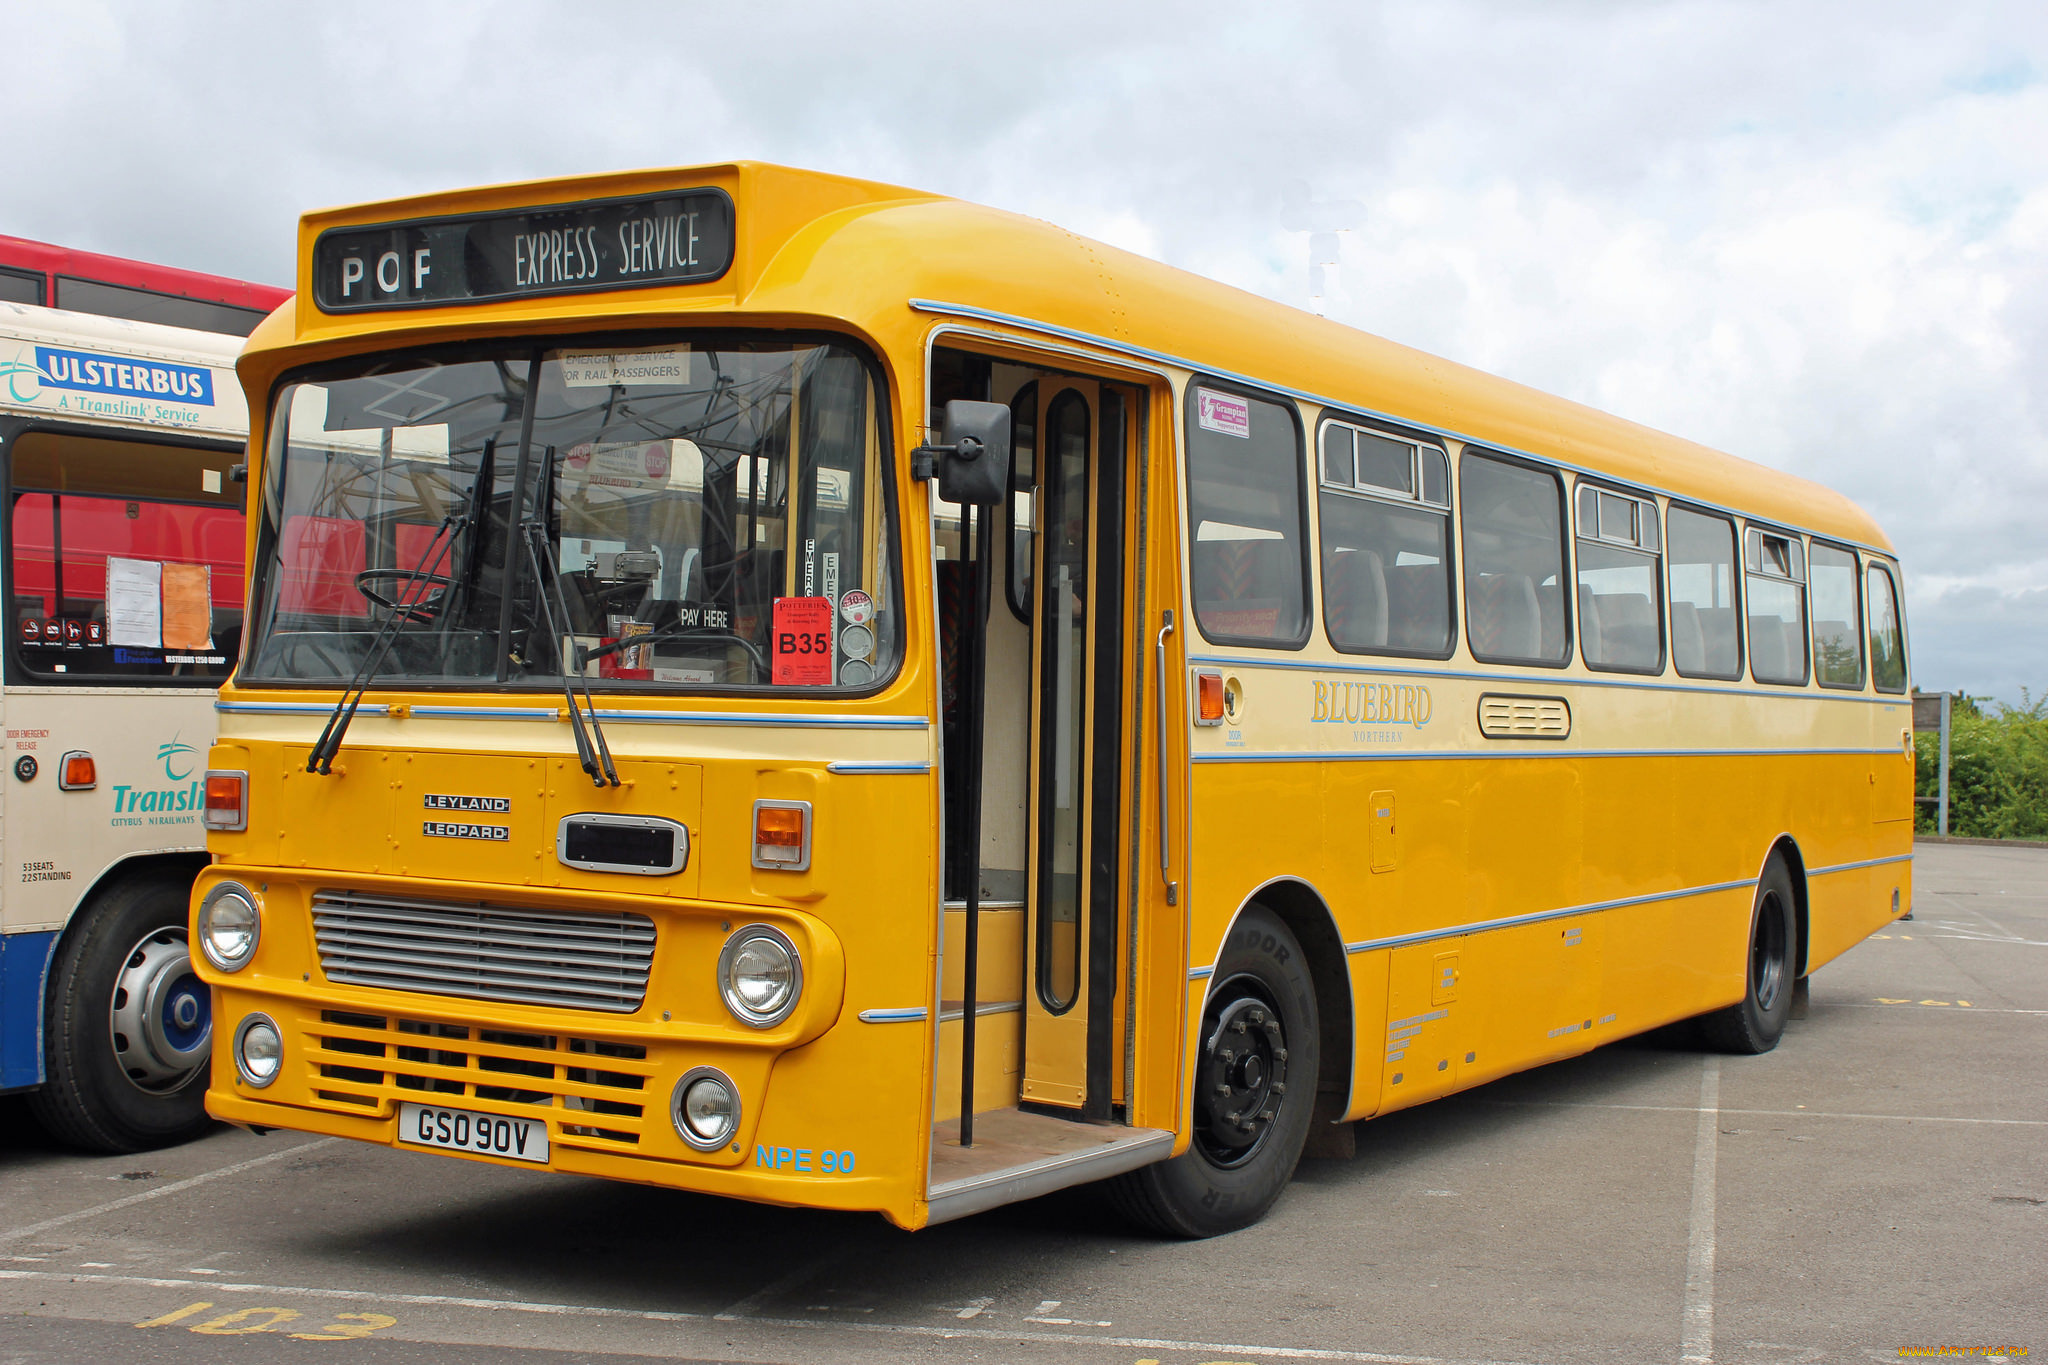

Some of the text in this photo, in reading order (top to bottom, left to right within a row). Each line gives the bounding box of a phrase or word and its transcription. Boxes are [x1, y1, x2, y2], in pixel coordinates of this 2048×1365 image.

[515, 213, 699, 286] EXPRESS SERVICE
[566, 350, 675, 365] EMERGENCY SERVICE
[48, 355, 203, 398] ULSTERBUS
[584, 370, 608, 380] RAIL
[612, 366, 680, 378] PASSENGERS
[59, 395, 68, 408] A
[155, 405, 200, 423] Service
[1216, 403, 1246, 418] Grampian
[567, 446, 590, 457] STOP
[646, 456, 666, 468] STOP
[805, 540, 814, 597] EMERG
[780, 603, 828, 611] POTTERIES
[681, 608, 728, 628] PAY HERE
[780, 633, 827, 654] B35
[165, 655, 195, 664] ULSTERBUS
[208, 656, 226, 665] GROUP
[1311, 680, 1433, 730] BLUEBIRD
[7, 729, 49, 738] DOOR EMERGENCY
[1353, 730, 1403, 743] NORTHERN
[16, 741, 37, 750] RELEASE
[112, 781, 204, 813] Transli
[428, 796, 506, 811] LEYLAND
[111, 818, 142, 826] CITYBUS
[427, 823, 504, 838] LEOPARD
[755, 1144, 856, 1174] NPE 90
